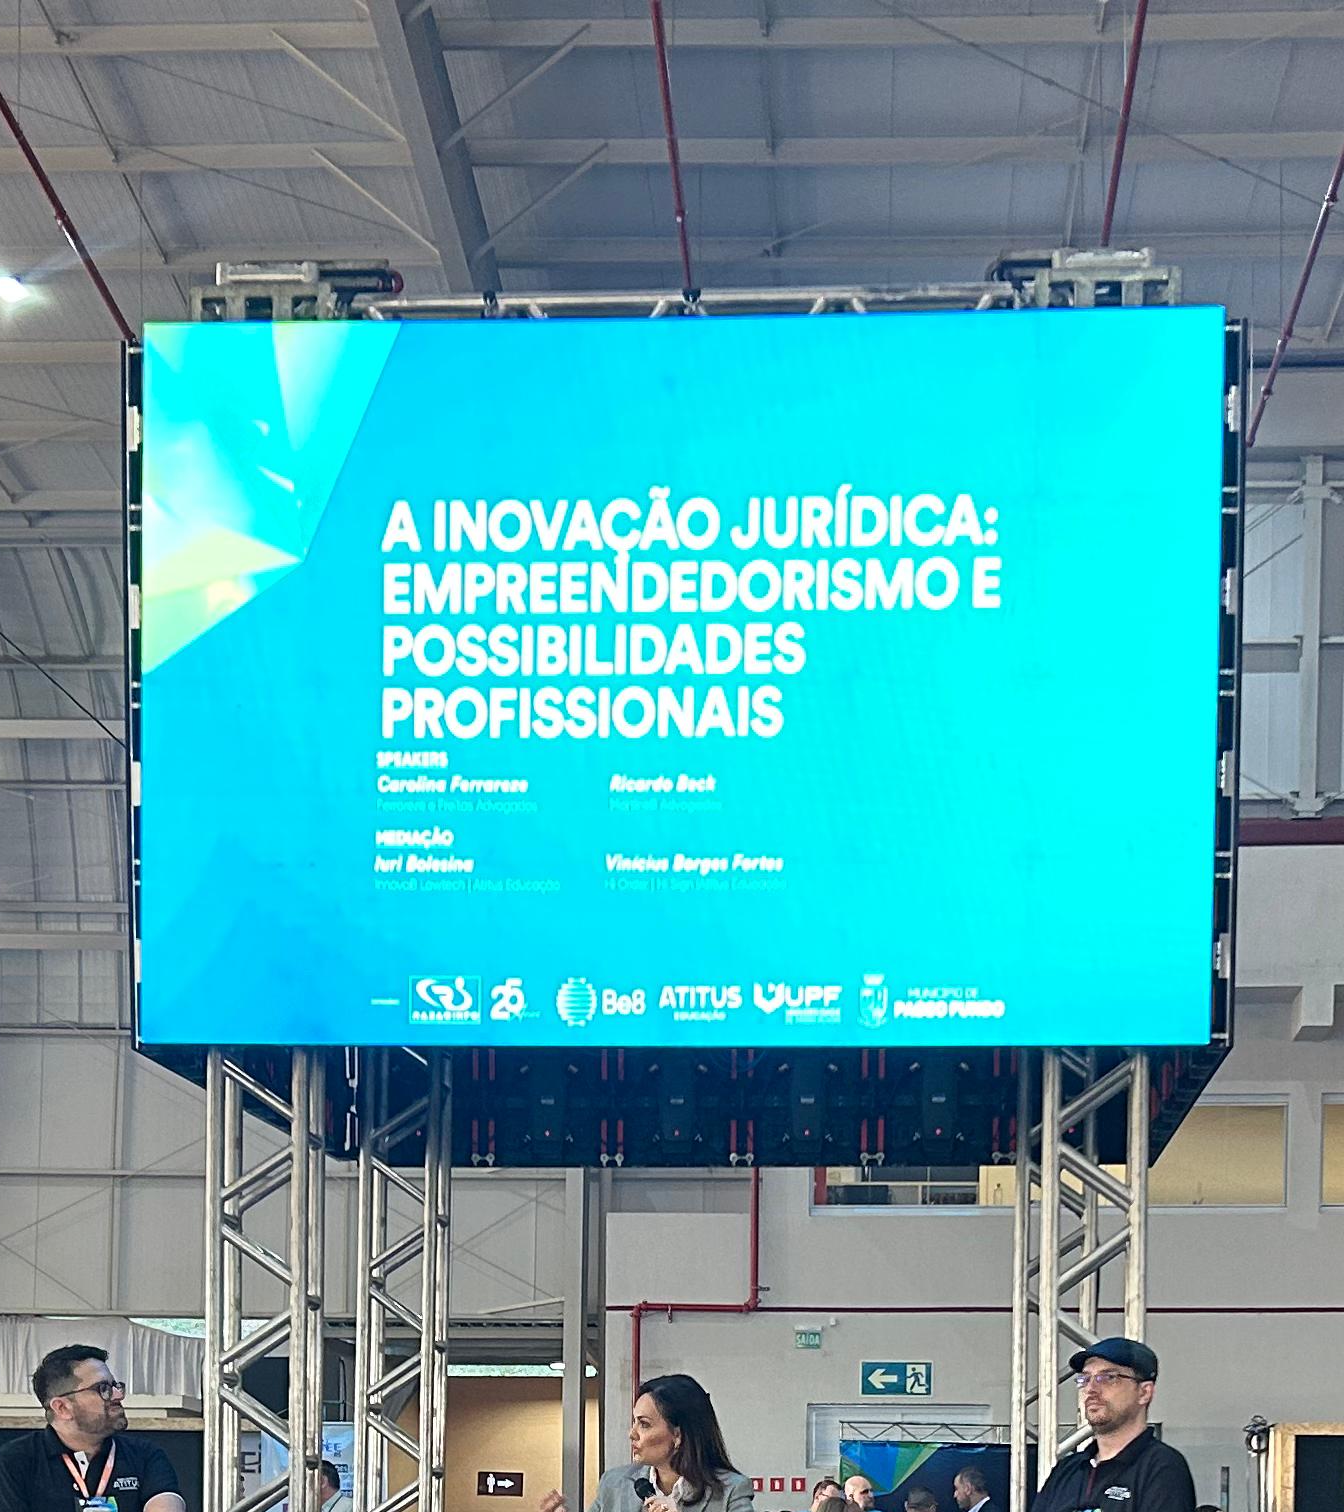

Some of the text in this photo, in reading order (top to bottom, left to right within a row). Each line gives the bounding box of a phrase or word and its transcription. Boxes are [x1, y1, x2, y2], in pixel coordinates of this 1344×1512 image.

[381, 483, 999, 565] A INOVAÇÃO JURÍDICA:
[383, 556, 1003, 615] EMPREENDEDORISMO E
[382, 621, 807, 678] POSSIBILIDADES
[381, 684, 785, 740] PROFISSIONAIS
[376, 751, 449, 769] SPEAKERS
[377, 774, 447, 793] Carolina
[609, 773, 717, 793] Ricardo Beck
[375, 826, 455, 849] MEDIAÇÃO
[672, 853, 729, 877] Borges
[731, 853, 784, 872] Fortes
[490, 977, 526, 1020] 25
[658, 985, 743, 1009] ATITUS
[783, 985, 843, 1008] UPF
[796, 1332, 820, 1345] SAÍDA
